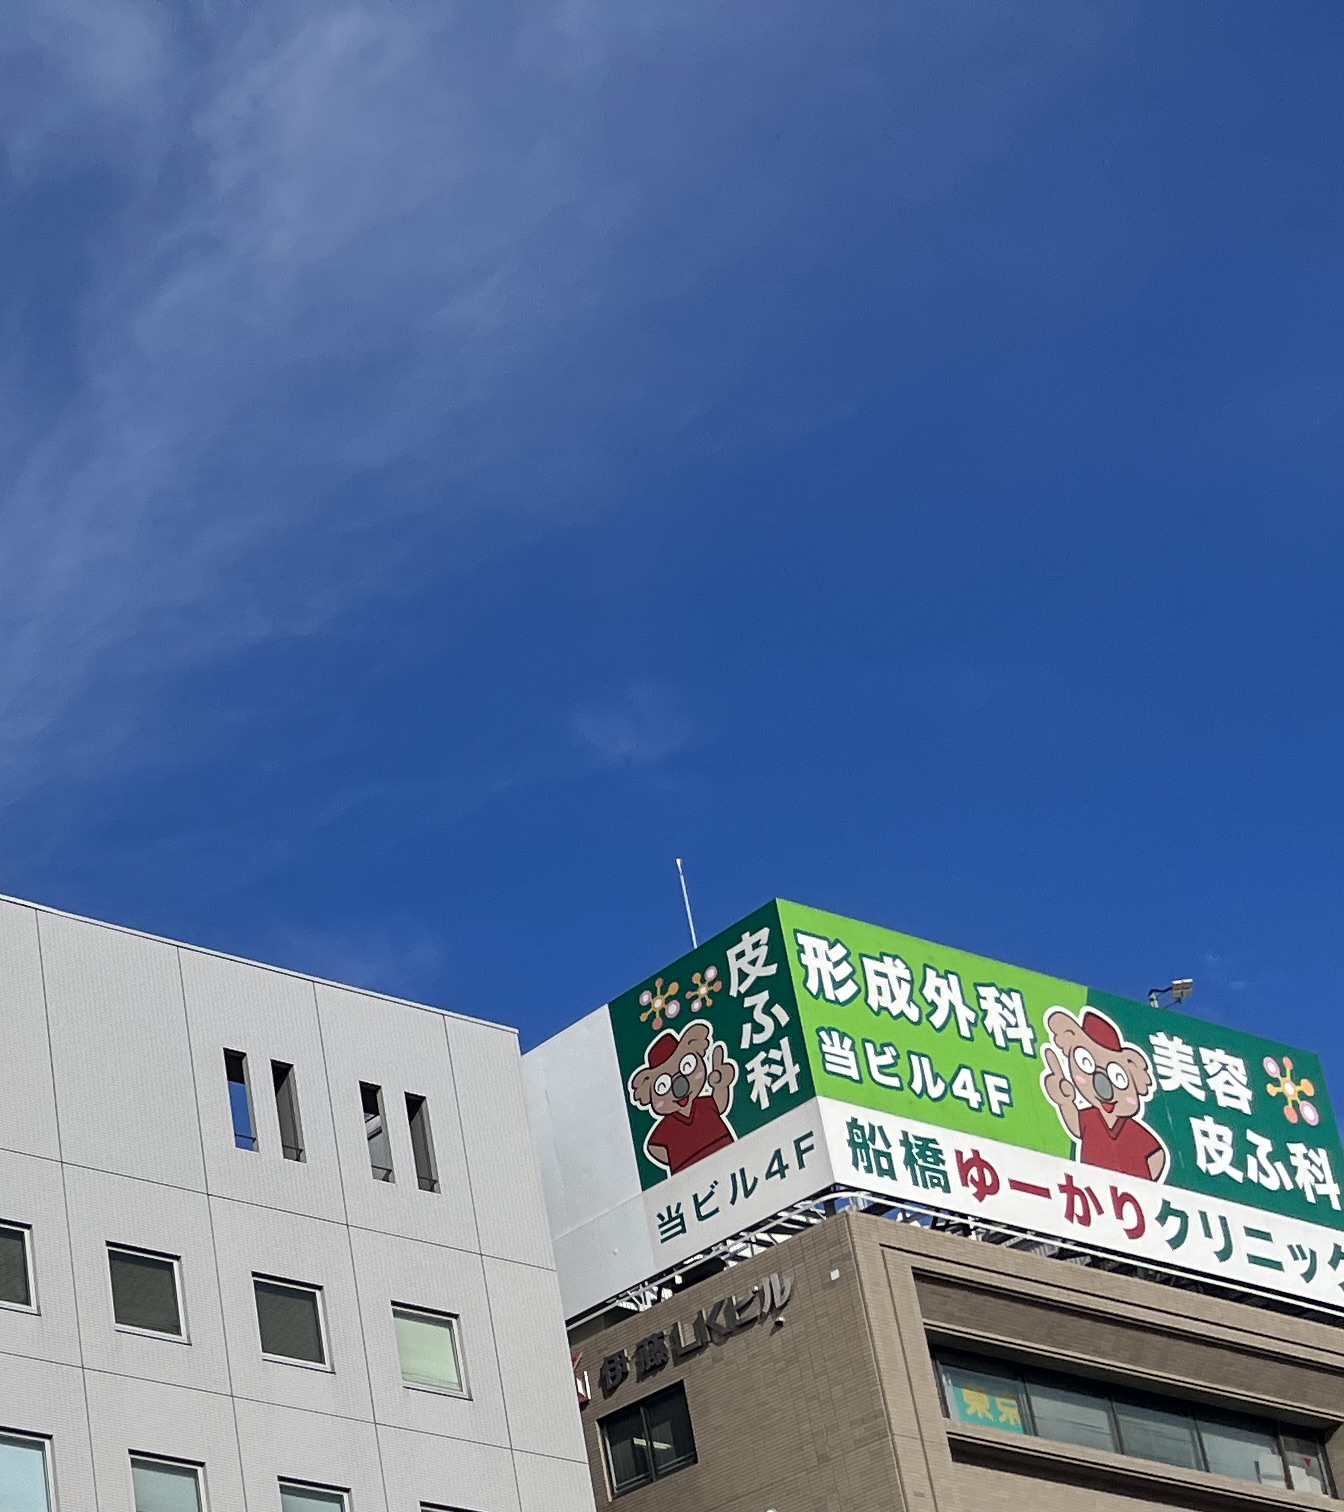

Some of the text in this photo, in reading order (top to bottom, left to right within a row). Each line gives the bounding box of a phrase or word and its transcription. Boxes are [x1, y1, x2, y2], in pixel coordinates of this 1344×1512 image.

[727, 924, 804, 1111] 皮ふ科
[795, 932, 1039, 1059] 形成外科
[818, 1029, 1016, 1117] 当ビル4F
[1149, 1031, 1254, 1115] 美容
[655, 1130, 816, 1246] 当ビル4F
[1188, 1114, 1343, 1212] 皮ふ科
